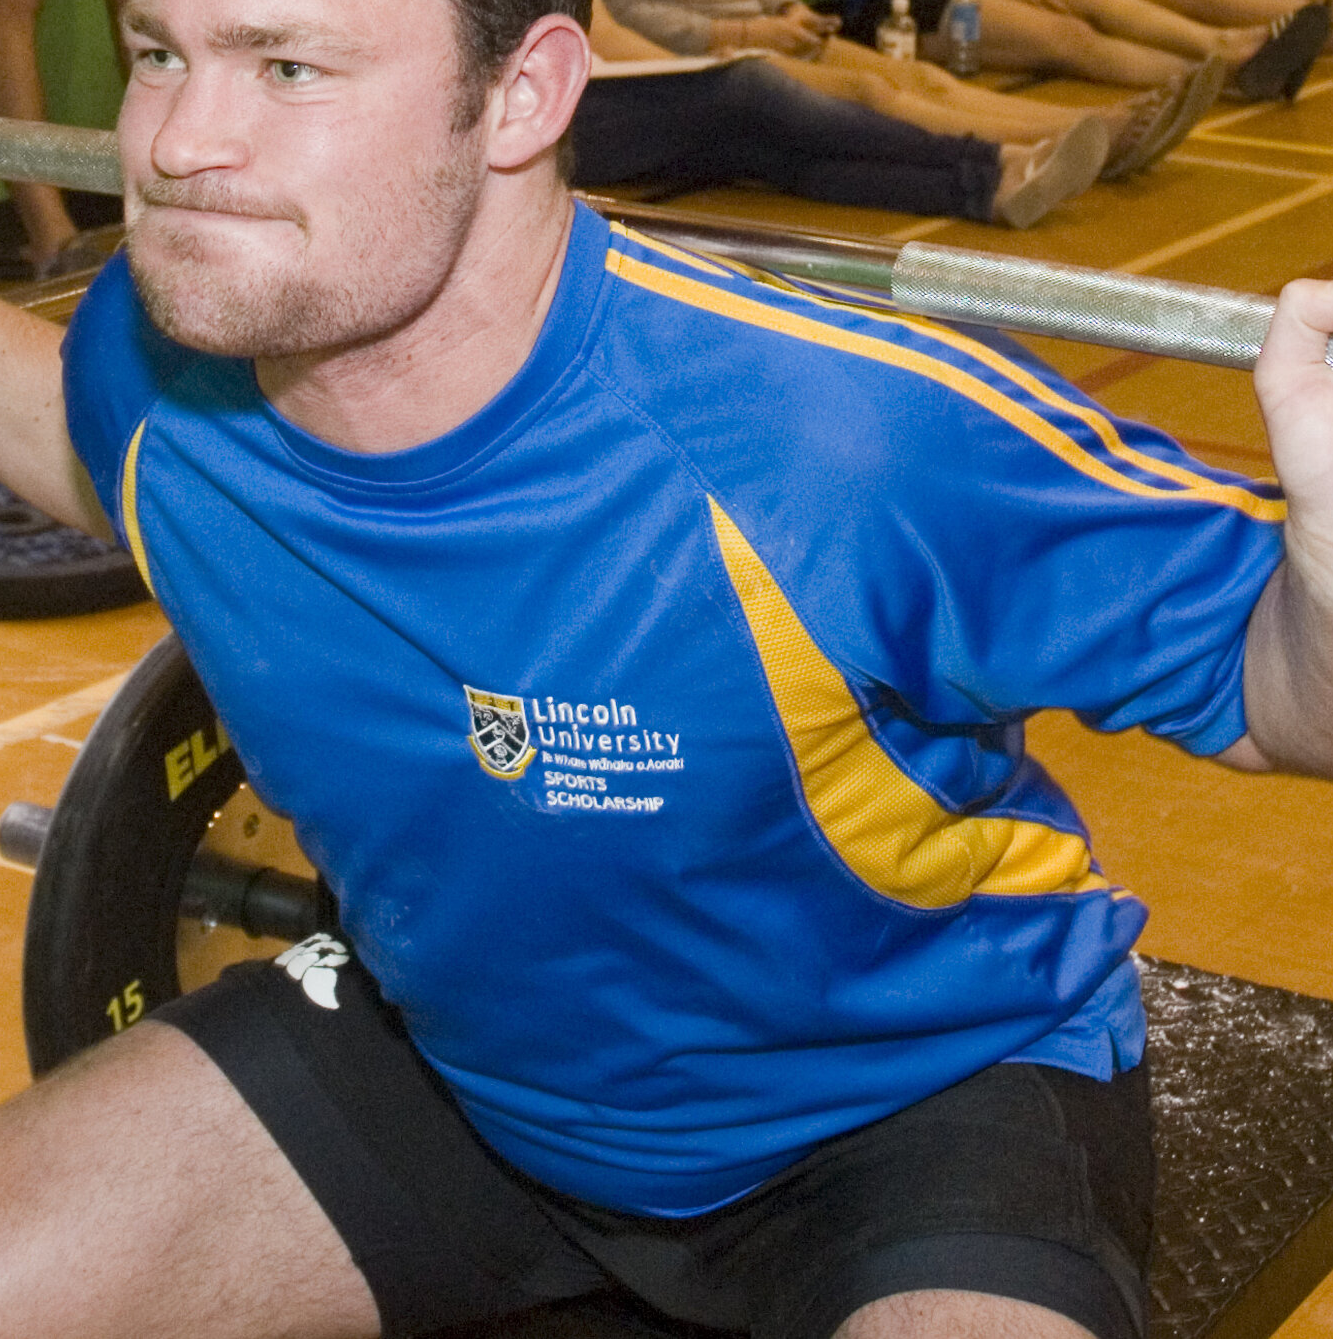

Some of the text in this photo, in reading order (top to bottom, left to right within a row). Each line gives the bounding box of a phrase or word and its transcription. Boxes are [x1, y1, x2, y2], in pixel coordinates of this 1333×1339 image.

[532, 696, 637, 726] Lincoln
[538, 724, 680, 755] University
[645, 757, 684, 771] Aoraki
[544, 770, 607, 792] SPORTS
[546, 790, 664, 811] SCHOLARSHIP
[106, 979, 143, 1031] 15
